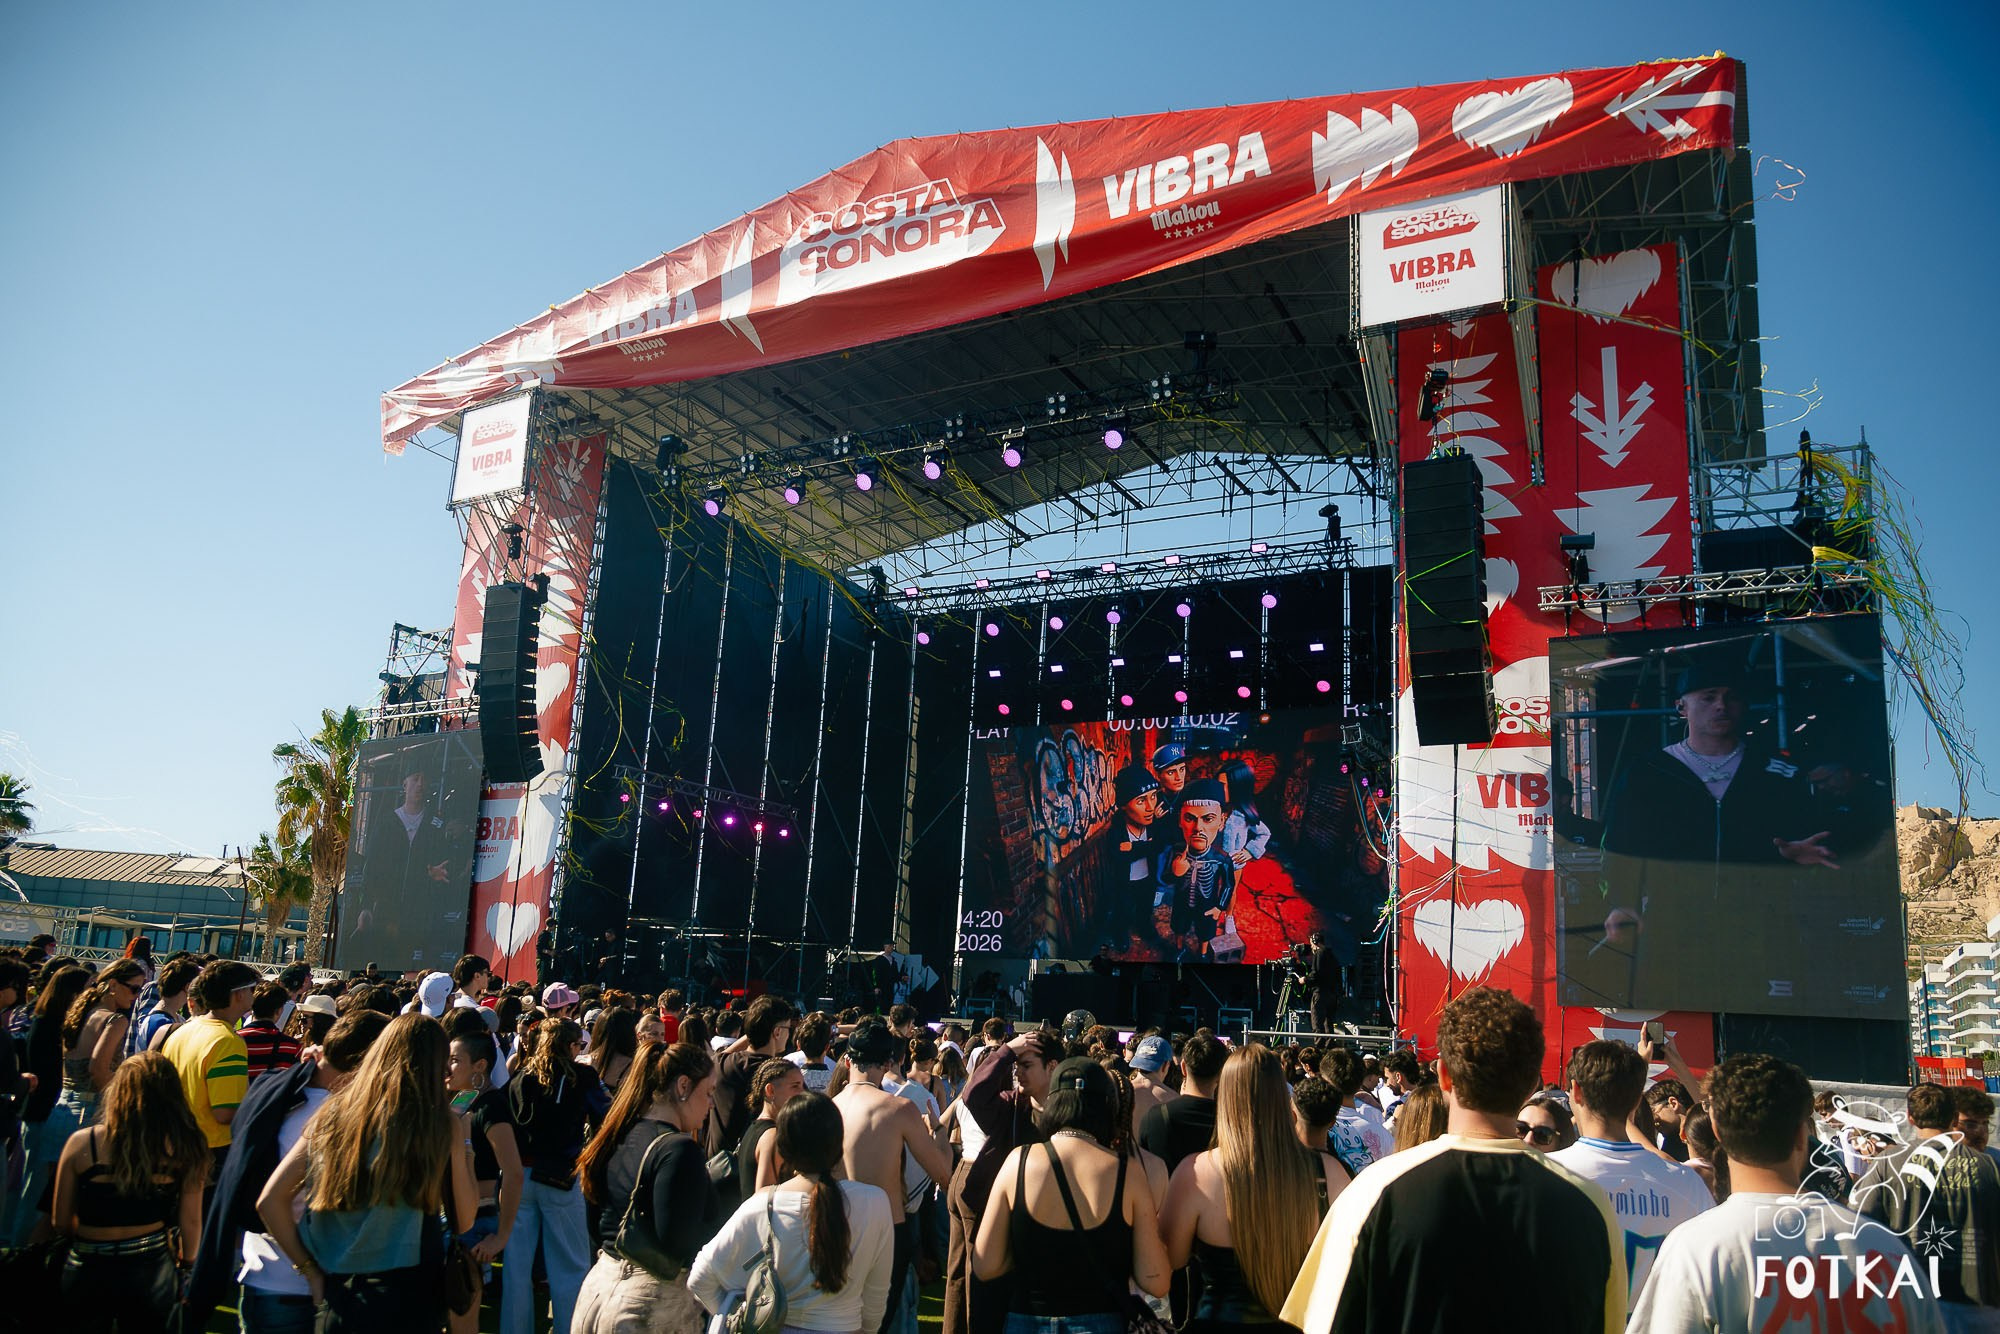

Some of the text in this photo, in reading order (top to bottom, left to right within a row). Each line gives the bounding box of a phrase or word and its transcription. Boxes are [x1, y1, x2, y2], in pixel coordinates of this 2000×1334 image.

[1102, 131, 1272, 220] VIBRA
[799, 178, 952, 244] COSTA
[1149, 200, 1221, 231] Mahou
[1391, 205, 1462, 229] COSTA
[798, 199, 1004, 277] SONORA
[1390, 212, 1480, 240] SONORA
[1389, 247, 1476, 284] VIBRA
[1415, 278, 1451, 291] Mahou
[616, 337, 668, 356] Mahou
[472, 448, 513, 472] VIBRA
[1476, 772, 1551, 809] VIB
[959, 933, 1002, 952] 2026
